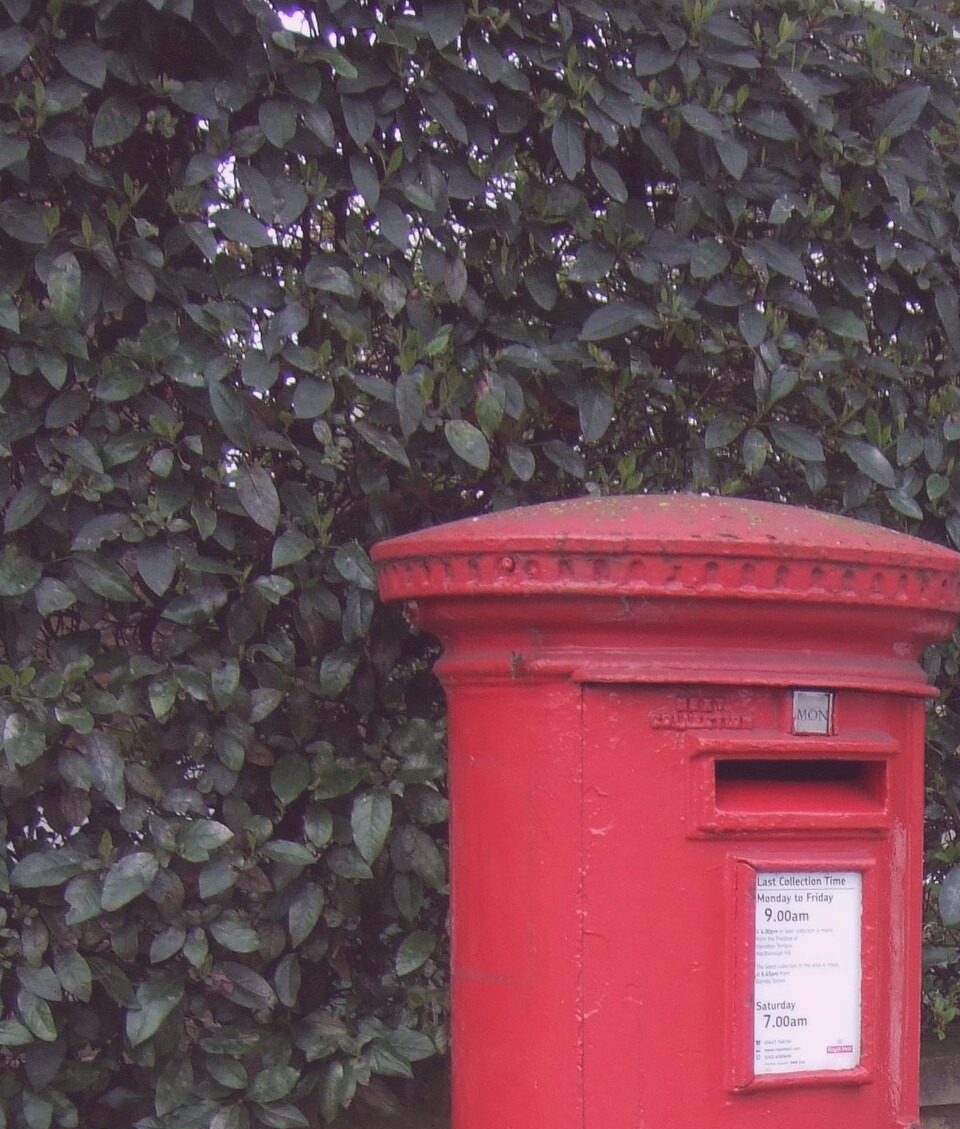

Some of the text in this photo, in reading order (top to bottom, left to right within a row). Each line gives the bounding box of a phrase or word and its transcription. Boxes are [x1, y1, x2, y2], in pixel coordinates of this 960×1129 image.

[796, 708, 828, 722] MON
[757, 875, 847, 887] Last Collection Time
[757, 892, 834, 905] Monday to Friday
[764, 907, 809, 922] 9.00am
[756, 1000, 796, 1011] Saturday
[763, 1014, 808, 1029] 7.00am
